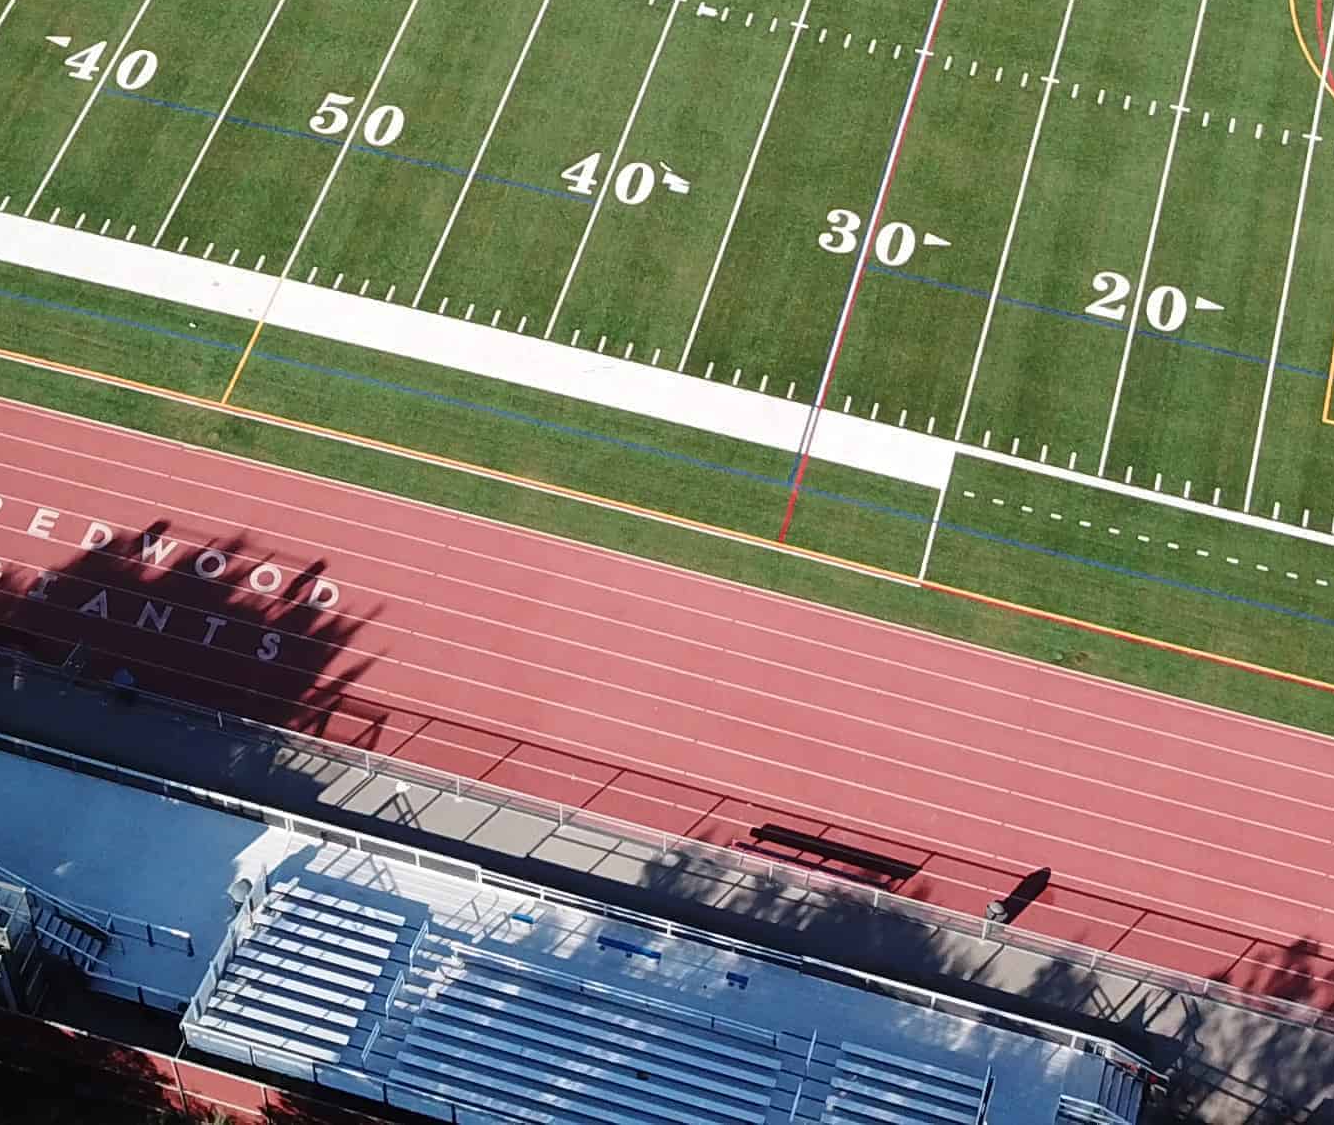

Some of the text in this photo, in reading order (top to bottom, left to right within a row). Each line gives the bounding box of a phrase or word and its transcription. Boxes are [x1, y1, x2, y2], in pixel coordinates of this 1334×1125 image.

[64, 40, 158, 90] 40
[308, 93, 405, 147] 50
[560, 152, 656, 206] 40
[818, 209, 916, 267] 30
[1085, 271, 1188, 331] 20
